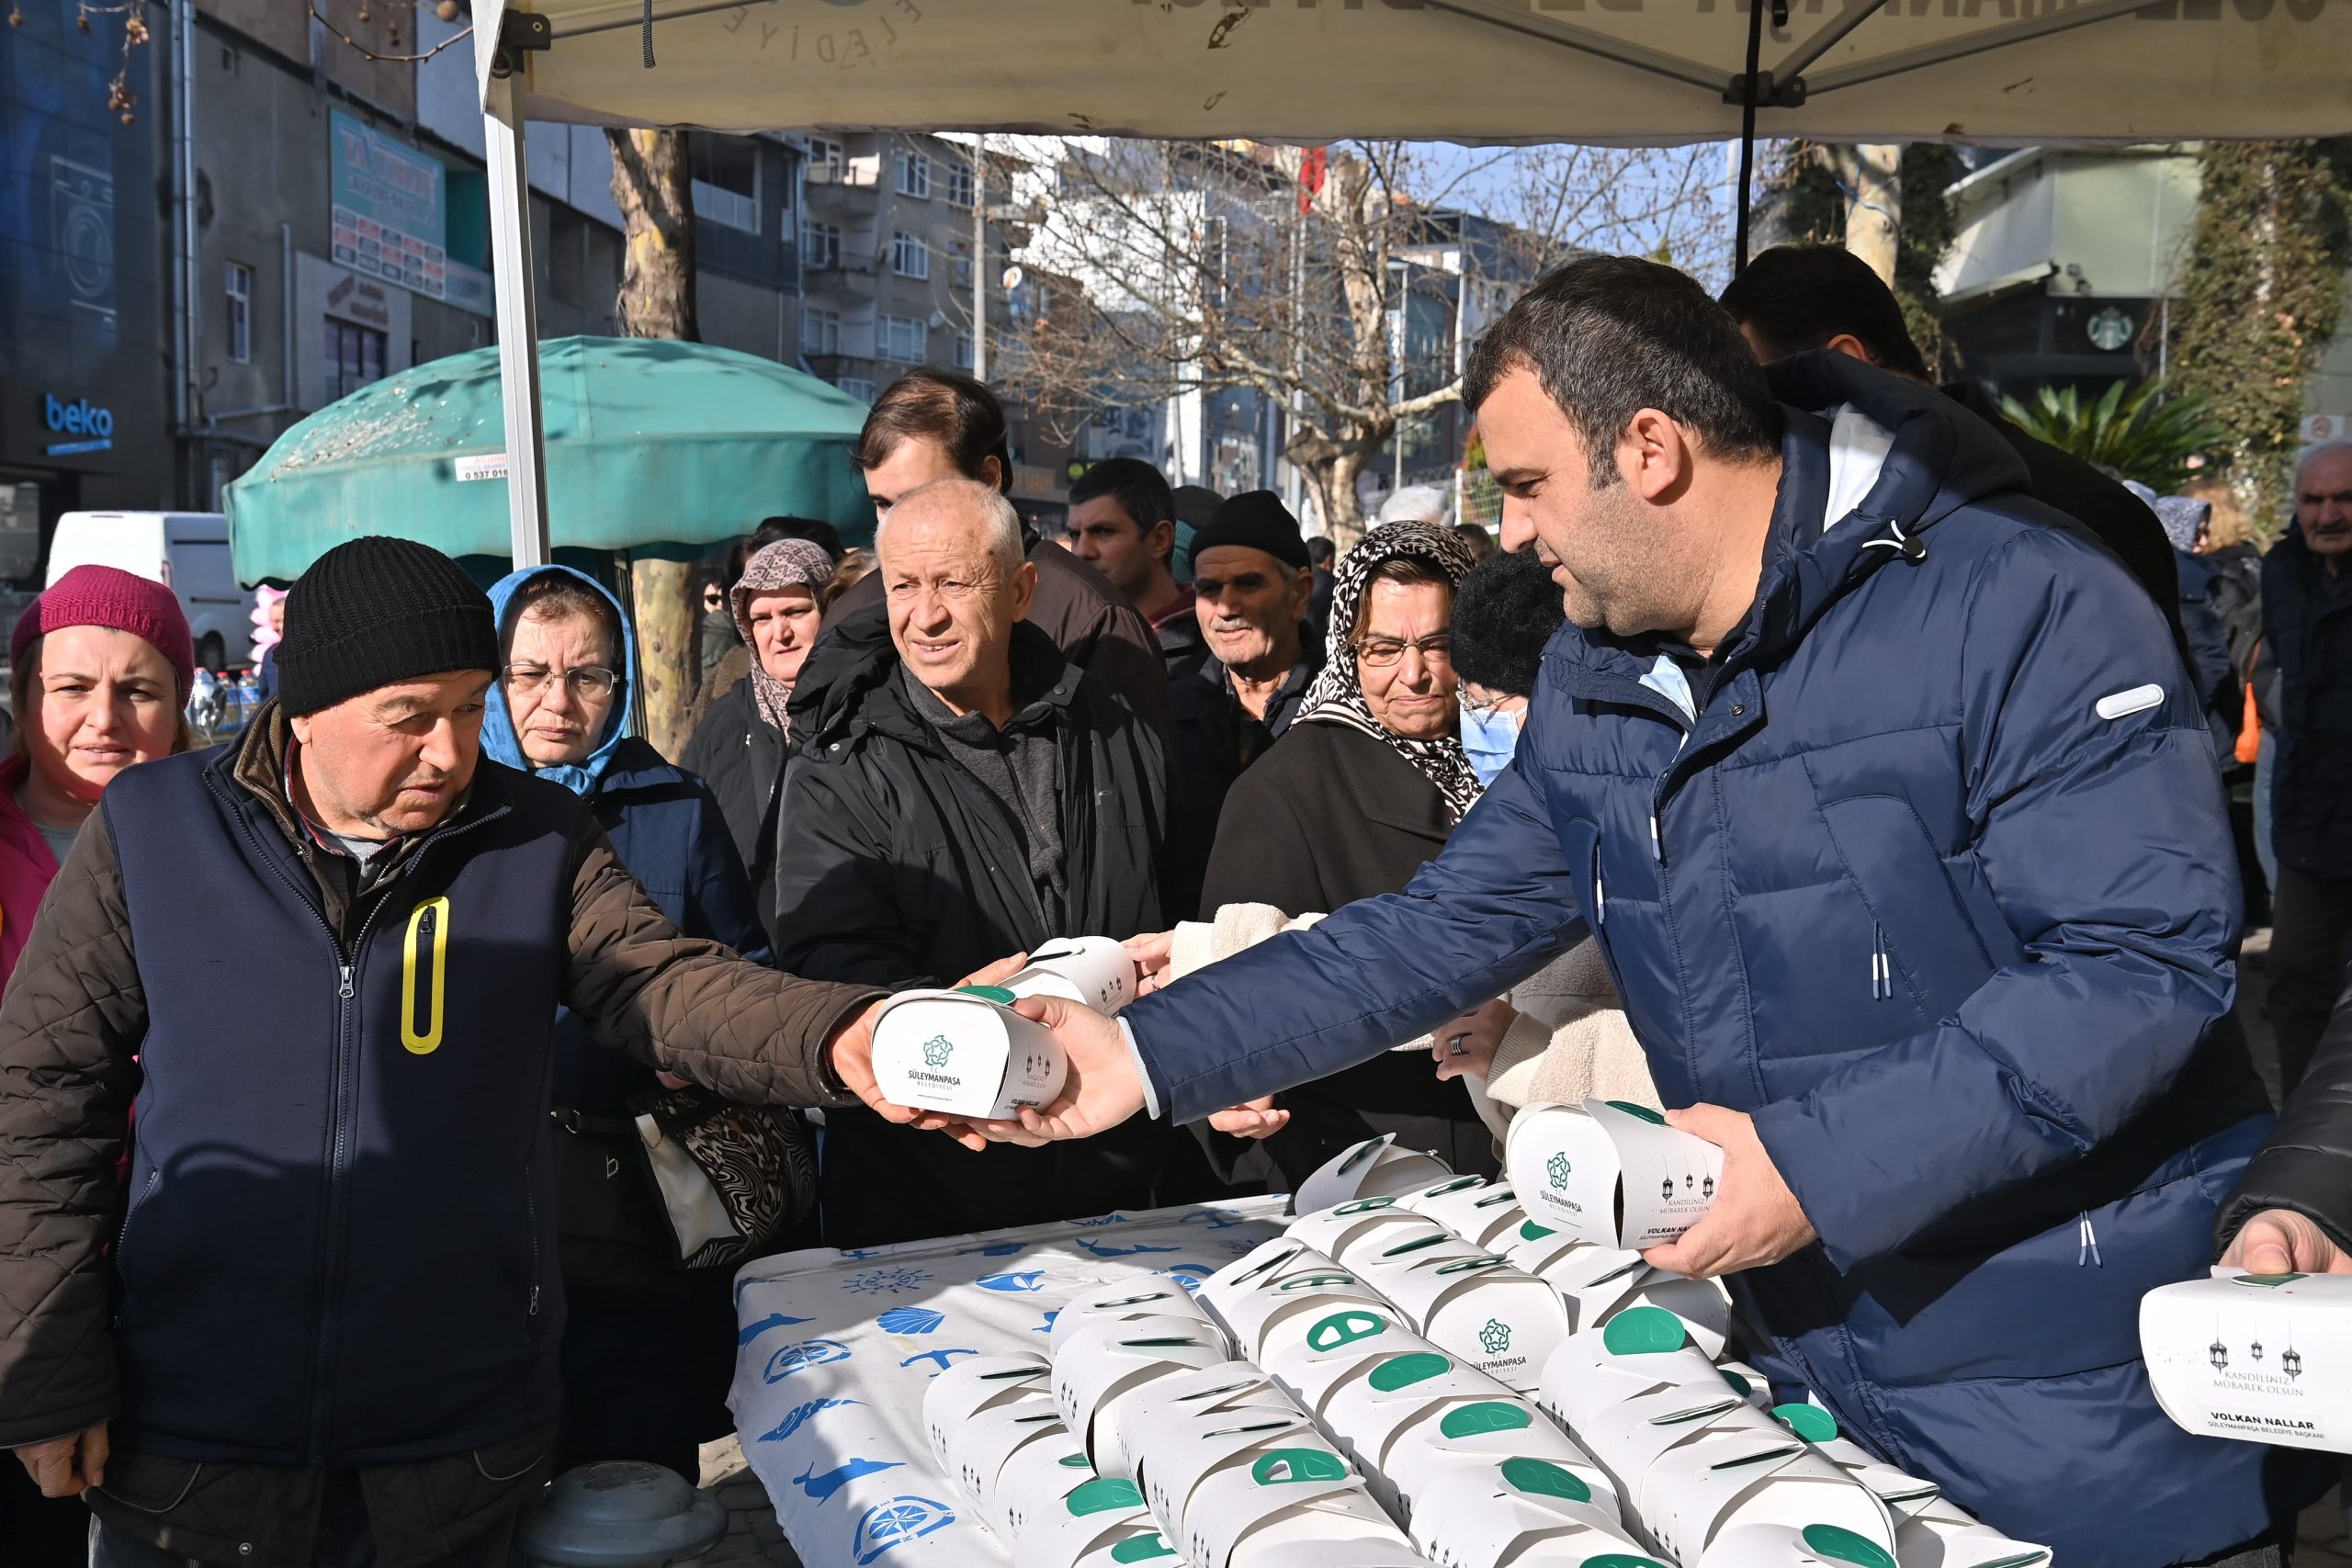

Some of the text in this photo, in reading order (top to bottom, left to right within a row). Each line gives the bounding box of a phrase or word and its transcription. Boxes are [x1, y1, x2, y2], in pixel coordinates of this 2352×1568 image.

[46, 393, 113, 436] beko
[473, 470, 490, 479] 537
[908, 1069, 961, 1086] SÜLEYMANPAŞA
[1540, 1190, 1583, 1213] SÜLEYMANPAŞA
[1659, 1206, 1689, 1214] MÜBAREK
[1647, 1226, 1677, 1235] VOLKAN
[2224, 1371, 2290, 1385] KANDİLİNİZ
[2213, 1379, 2303, 1397] MÜBAREK OLSUN
[2208, 1421, 2260, 1432] SÜLEYMANPAŞA
[2261, 1427, 2294, 1437] BELEDİYE
[2211, 1412, 2315, 1430] VOLKAN NALLAR
